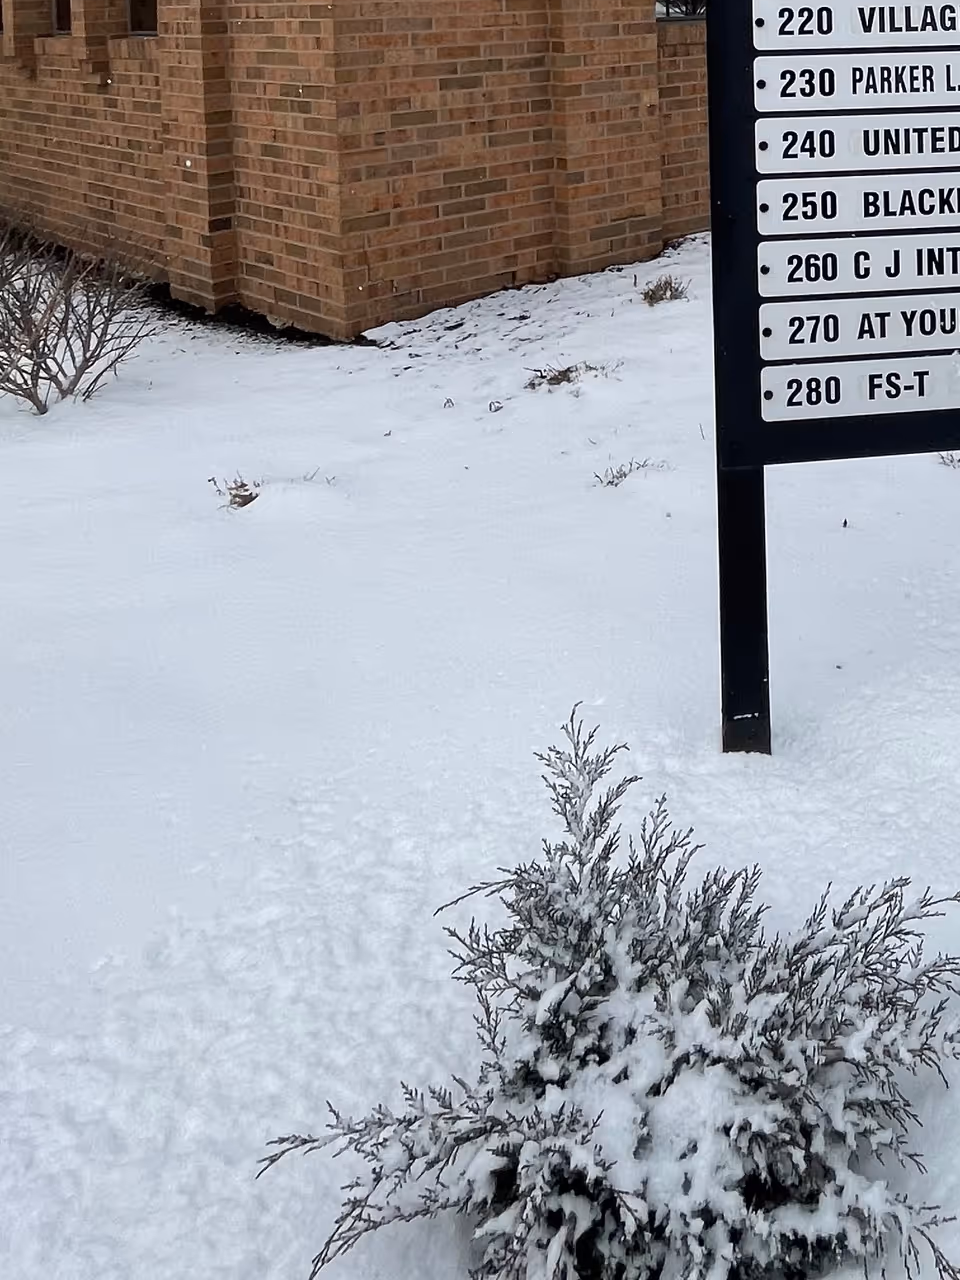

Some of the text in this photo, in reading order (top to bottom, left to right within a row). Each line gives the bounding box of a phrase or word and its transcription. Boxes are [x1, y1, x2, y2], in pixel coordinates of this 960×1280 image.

[779, 7, 832, 35] 220
[780, 69, 834, 97] 230
[852, 66, 934, 94] PARKER
[946, 65, 960, 91] L.
[783, 130, 835, 159] 240
[783, 191, 836, 221] 250
[788, 253, 837, 282] 260
[854, 251, 870, 279] C
[886, 250, 900, 277] J
[789, 314, 839, 344] 270
[858, 312, 890, 339] AT
[787, 371, 929, 407] 280 FS-T
